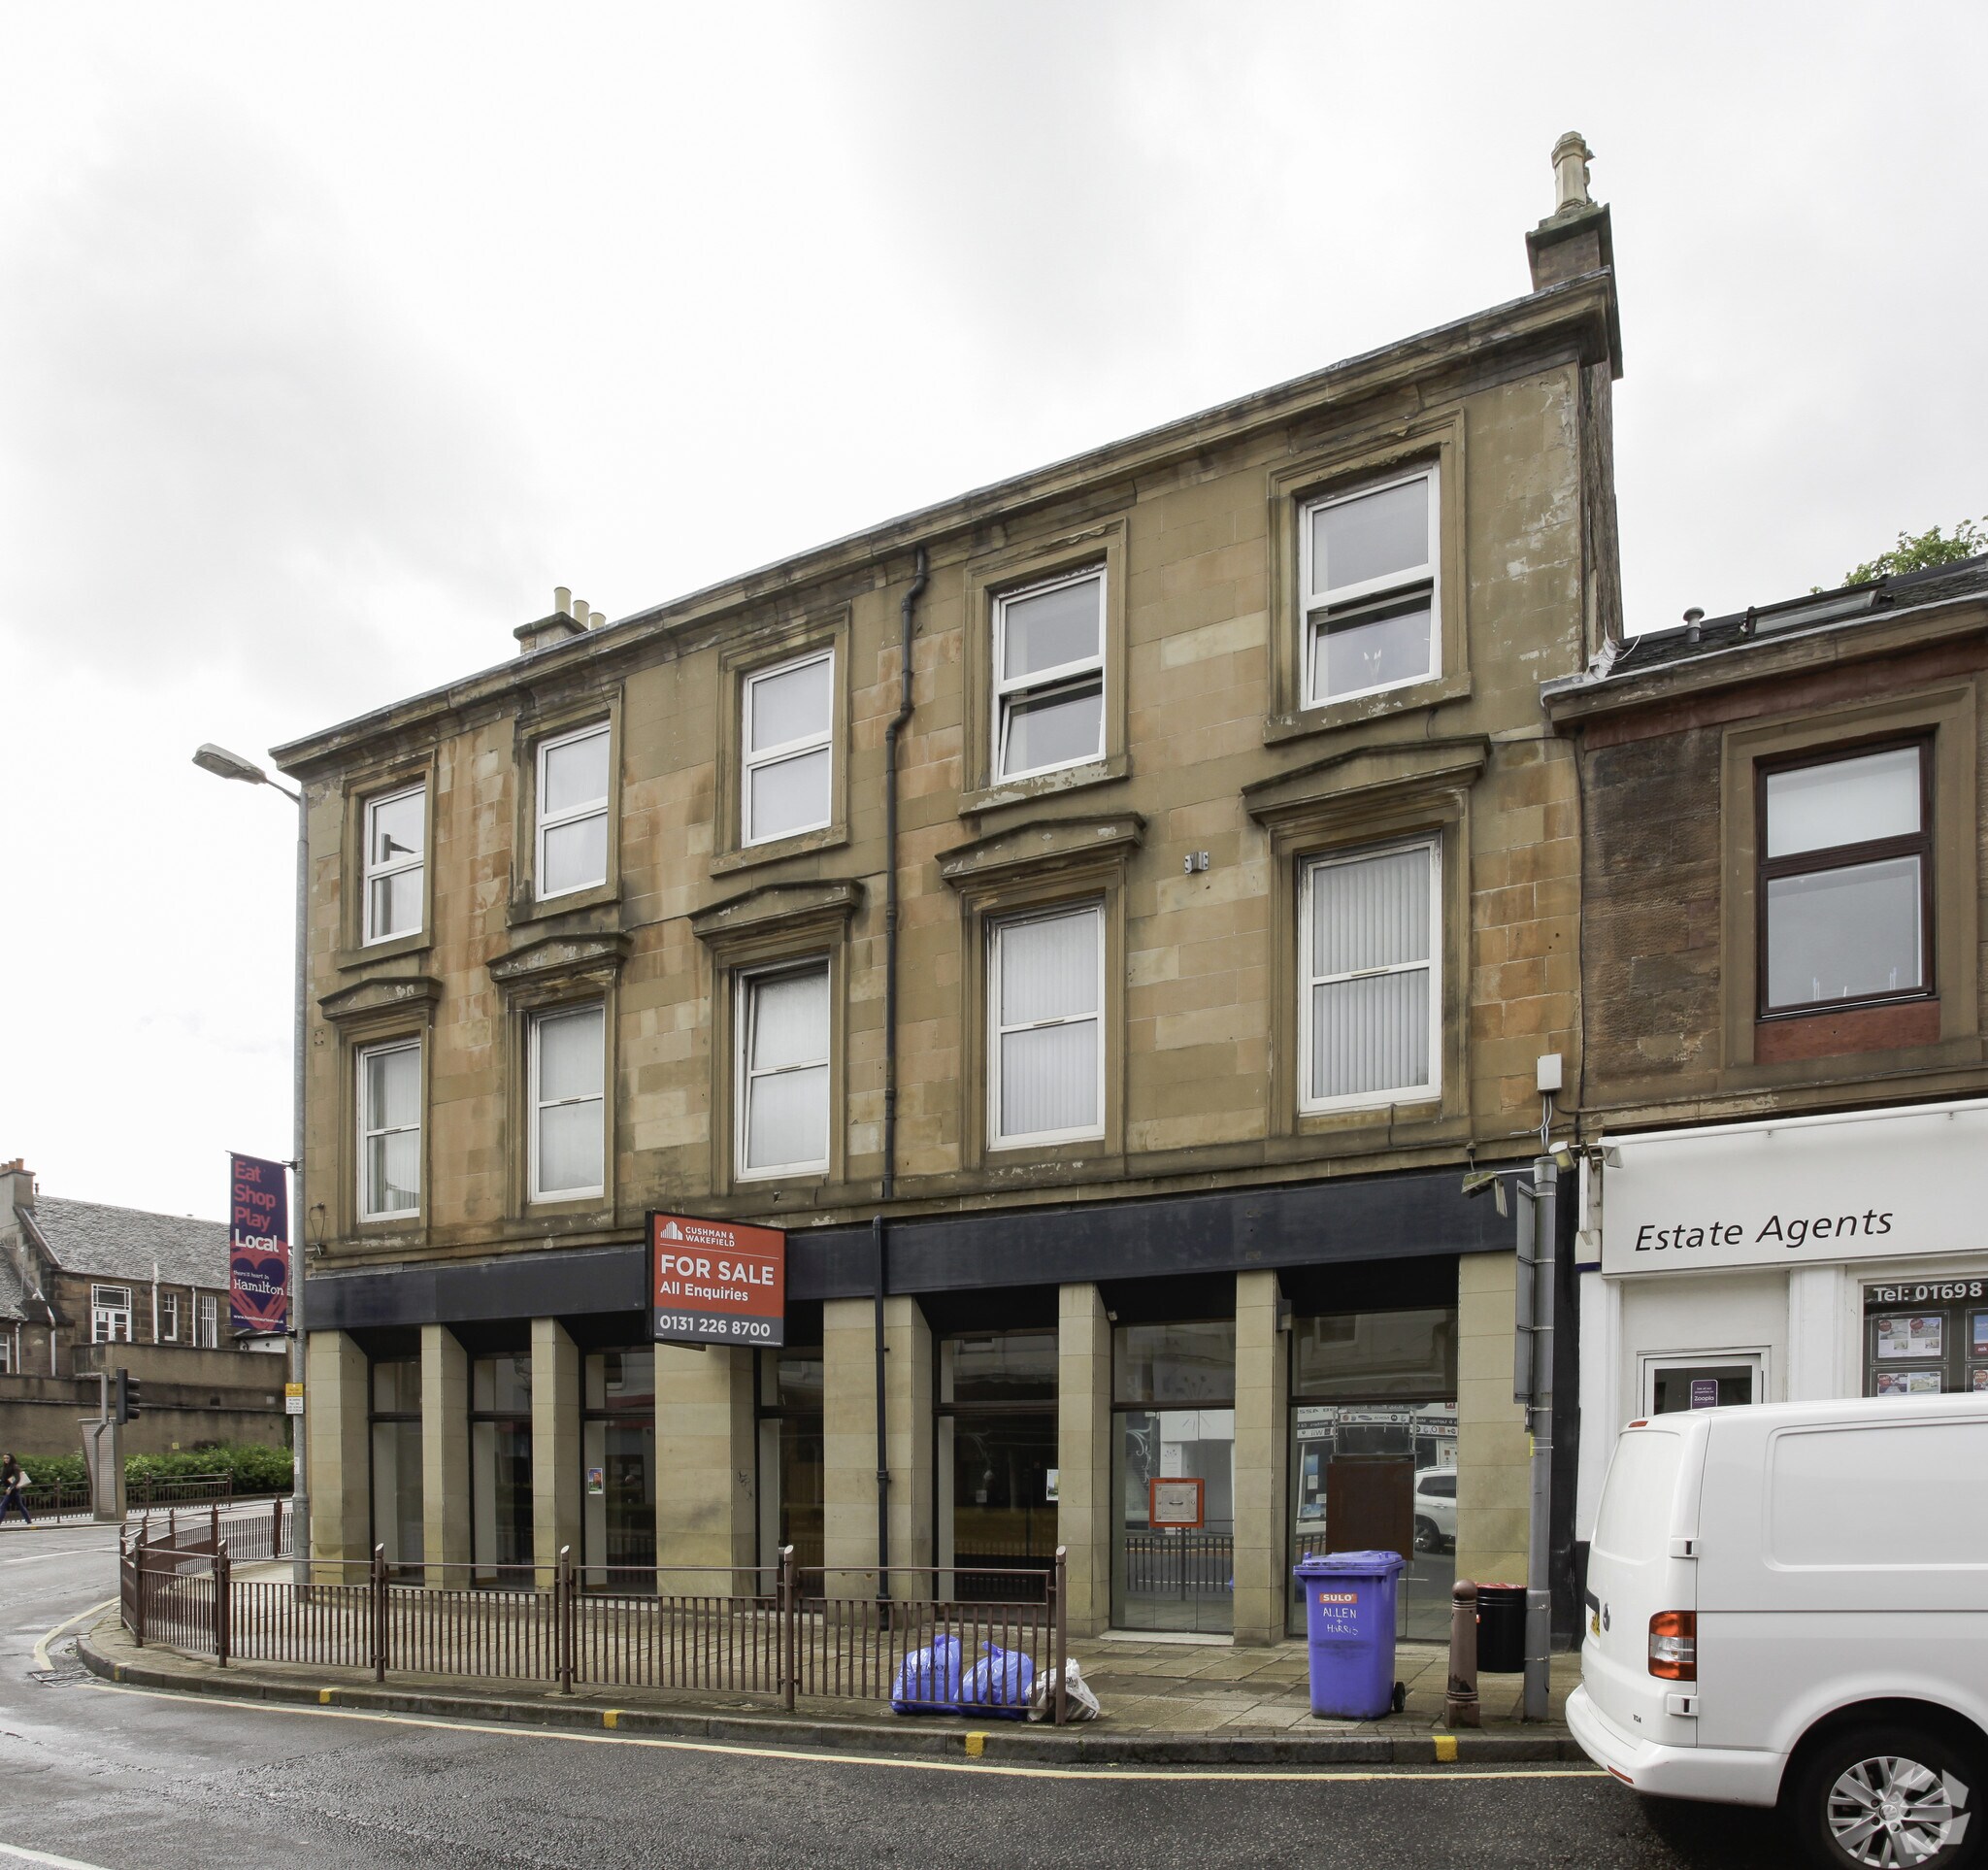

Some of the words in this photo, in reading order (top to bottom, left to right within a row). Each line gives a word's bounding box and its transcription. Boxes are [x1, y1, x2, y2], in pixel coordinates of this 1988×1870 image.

[235, 1160, 261, 1183] Eat
[234, 1184, 276, 1211] Shop
[234, 1206, 271, 1232] Play
[235, 1228, 280, 1252] Local
[685, 1226, 727, 1238] CUSHMAN
[685, 1234, 735, 1248] WAKEFIELD
[1635, 1220, 1743, 1252] Estate
[1755, 1209, 1893, 1249] Agents
[661, 1254, 711, 1279] FOR
[718, 1260, 775, 1286] SALE
[233, 1279, 284, 1296] Hamilton
[660, 1281, 679, 1295] All
[684, 1283, 748, 1301] Enquiries
[1873, 1286, 1909, 1302] Tel:
[1915, 1282, 1982, 1300] 01698
[660, 1315, 694, 1331] 0131
[699, 1319, 727, 1333] 226
[732, 1321, 771, 1337] 8700
